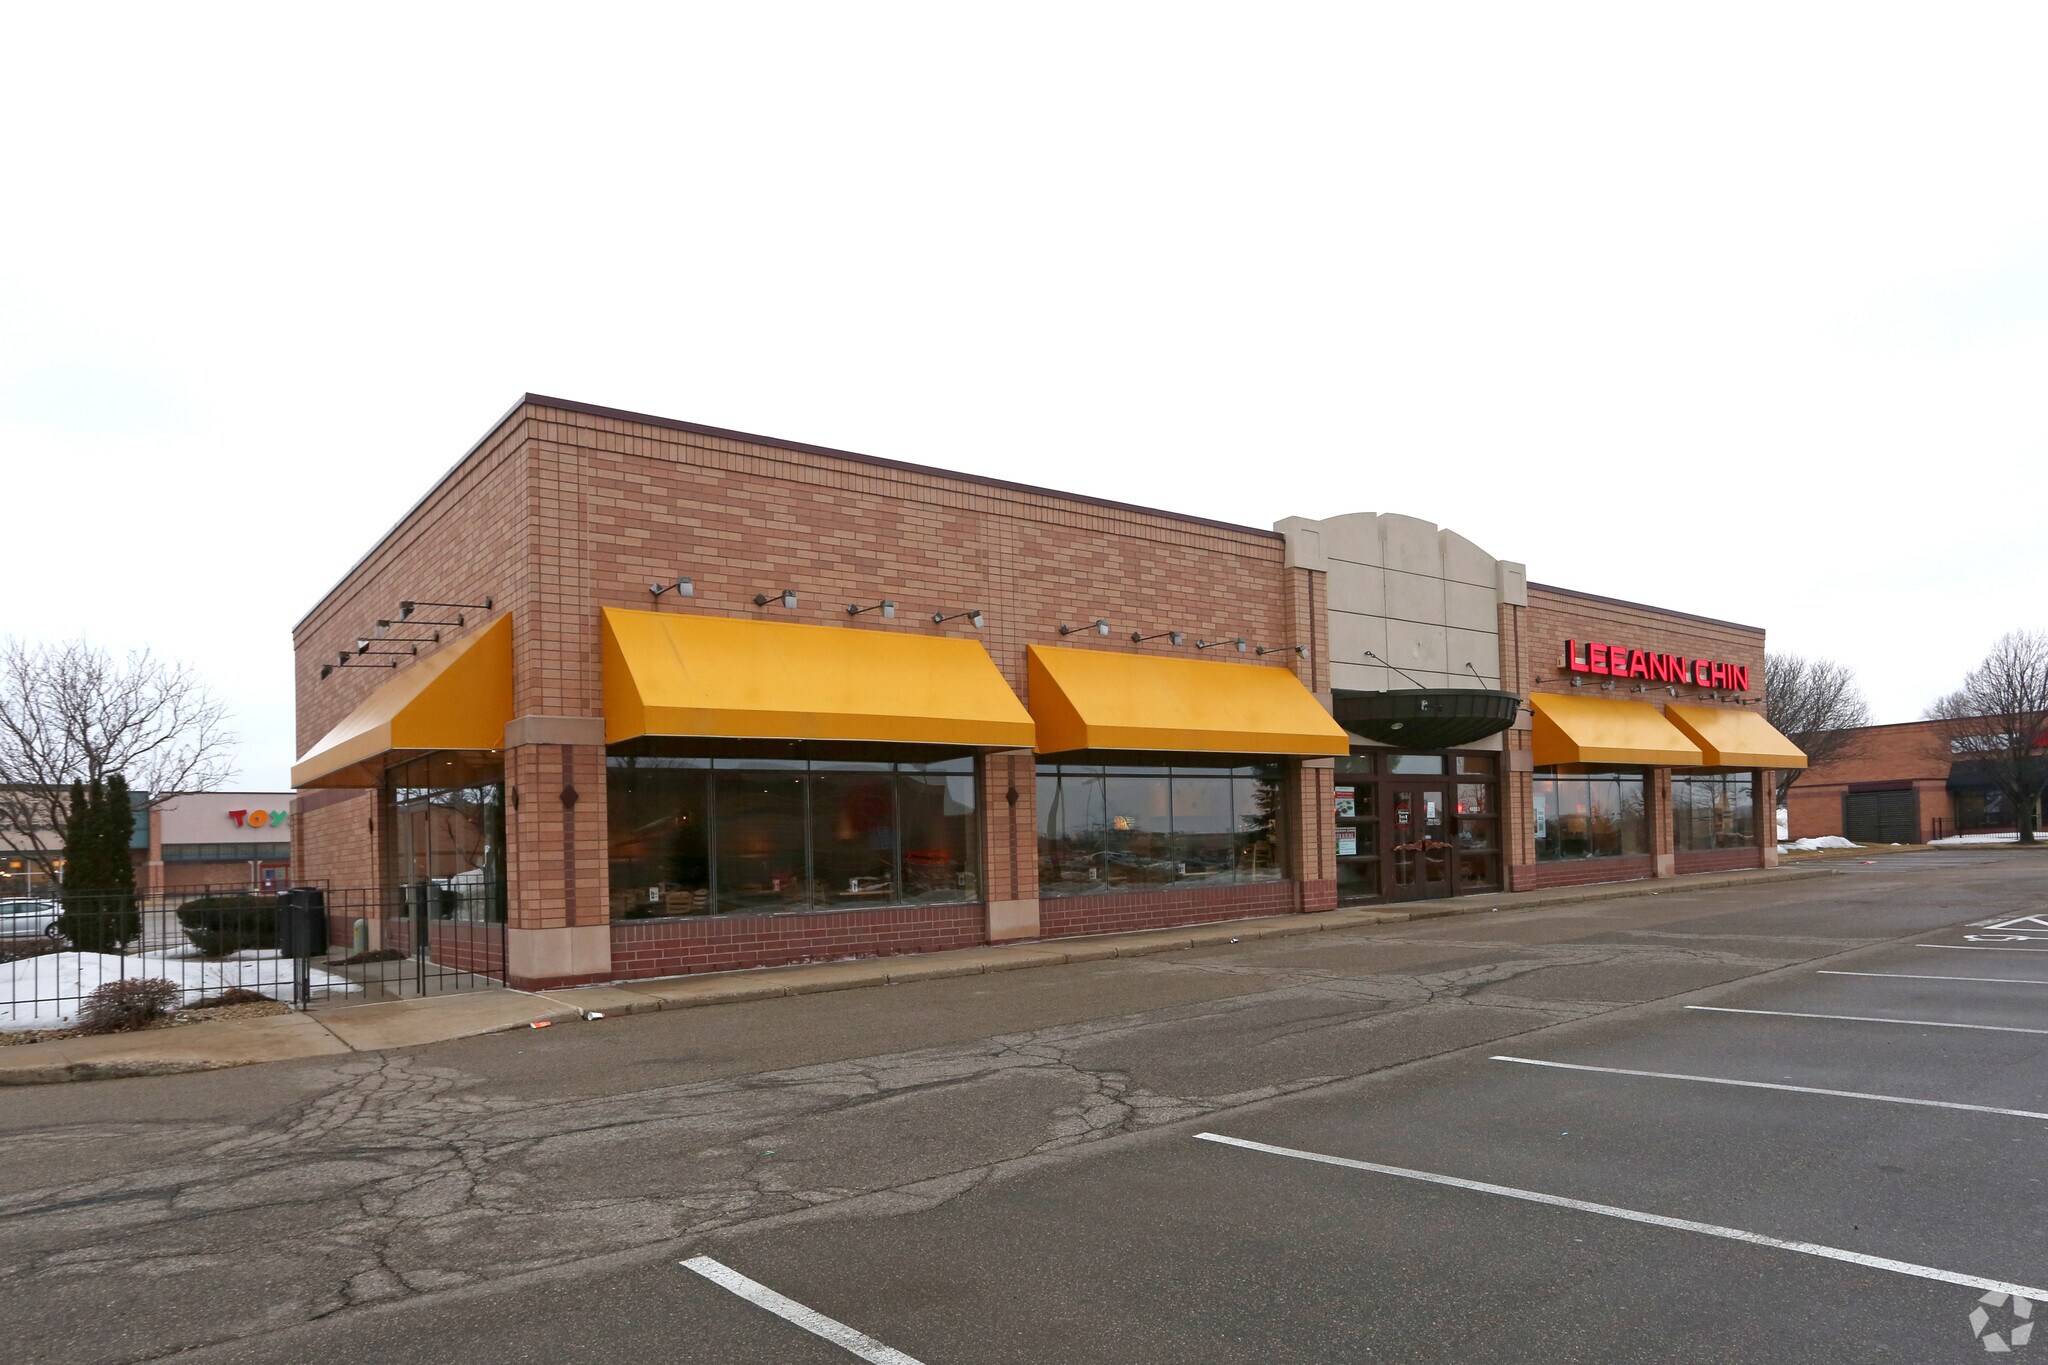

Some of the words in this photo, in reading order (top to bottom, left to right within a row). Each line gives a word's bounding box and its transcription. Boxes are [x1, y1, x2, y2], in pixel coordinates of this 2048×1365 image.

[1566, 639, 1687, 683] LEEANN
[1692, 659, 1749, 691] CHIN
[227, 809, 288, 828] TOY
